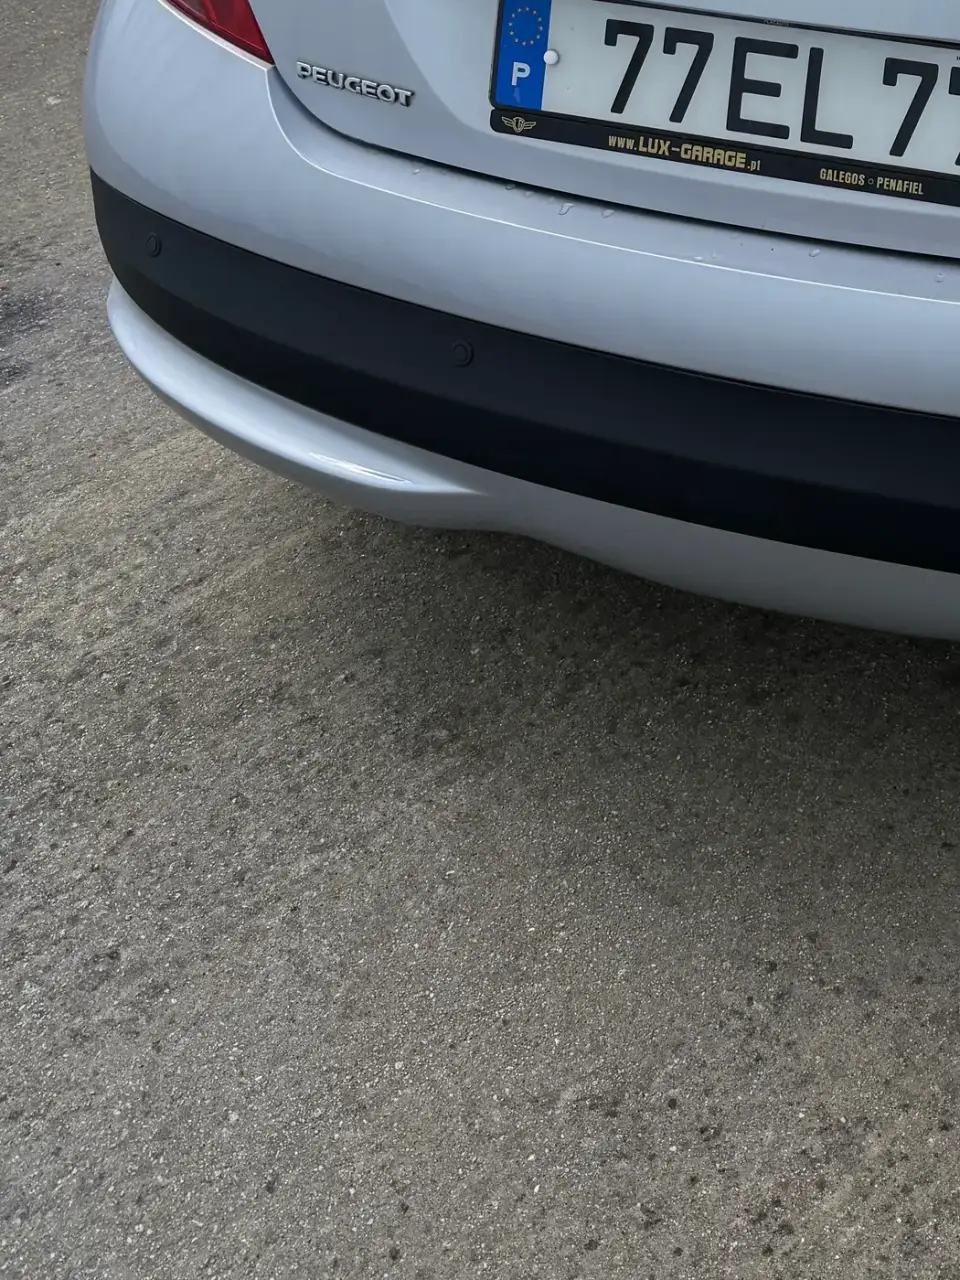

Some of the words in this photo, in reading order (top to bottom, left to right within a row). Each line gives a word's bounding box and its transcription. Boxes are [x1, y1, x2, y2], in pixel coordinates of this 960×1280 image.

[296, 60, 415, 107] PEUGEOT
[511, 61, 531, 86] P
[819, 168, 866, 187] GALEGOS
[876, 177, 924, 195] PENAFIEL
